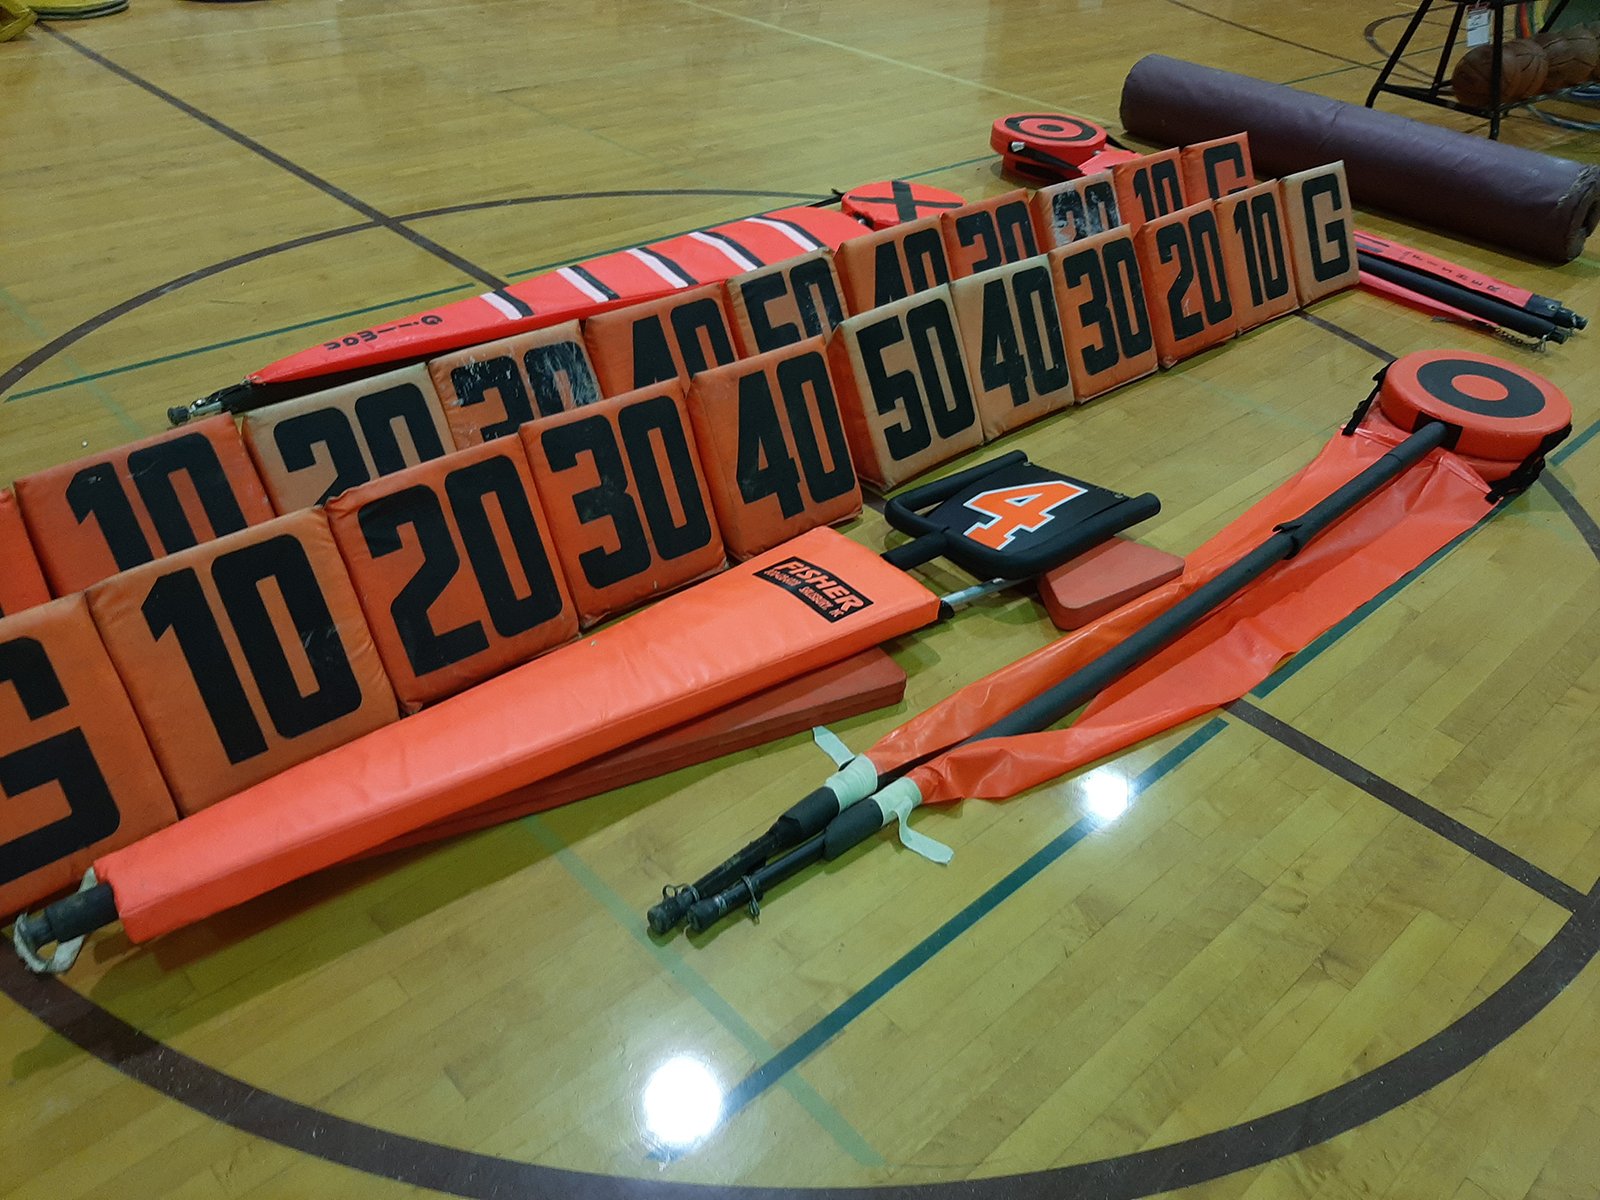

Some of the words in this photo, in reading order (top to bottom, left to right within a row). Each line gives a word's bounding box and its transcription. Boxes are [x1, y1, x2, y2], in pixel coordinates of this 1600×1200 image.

[1133, 159, 1182, 222] 10
[1233, 191, 1289, 308] 10
[1302, 173, 1350, 282] G
[741, 257, 848, 354] 50
[980, 265, 1069, 407] 40
[1063, 237, 1153, 376] 30
[1156, 209, 1232, 341] 20
[273, 382, 446, 507] 20
[736, 351, 855, 520] 40
[856, 298, 976, 461] 50
[66, 432, 248, 571] 10
[540, 395, 712, 590] 30
[963, 480, 1088, 550] 4
[357, 454, 563, 677] 20
[773, 560, 865, 612] FISHER
[141, 534, 362, 765] 10
